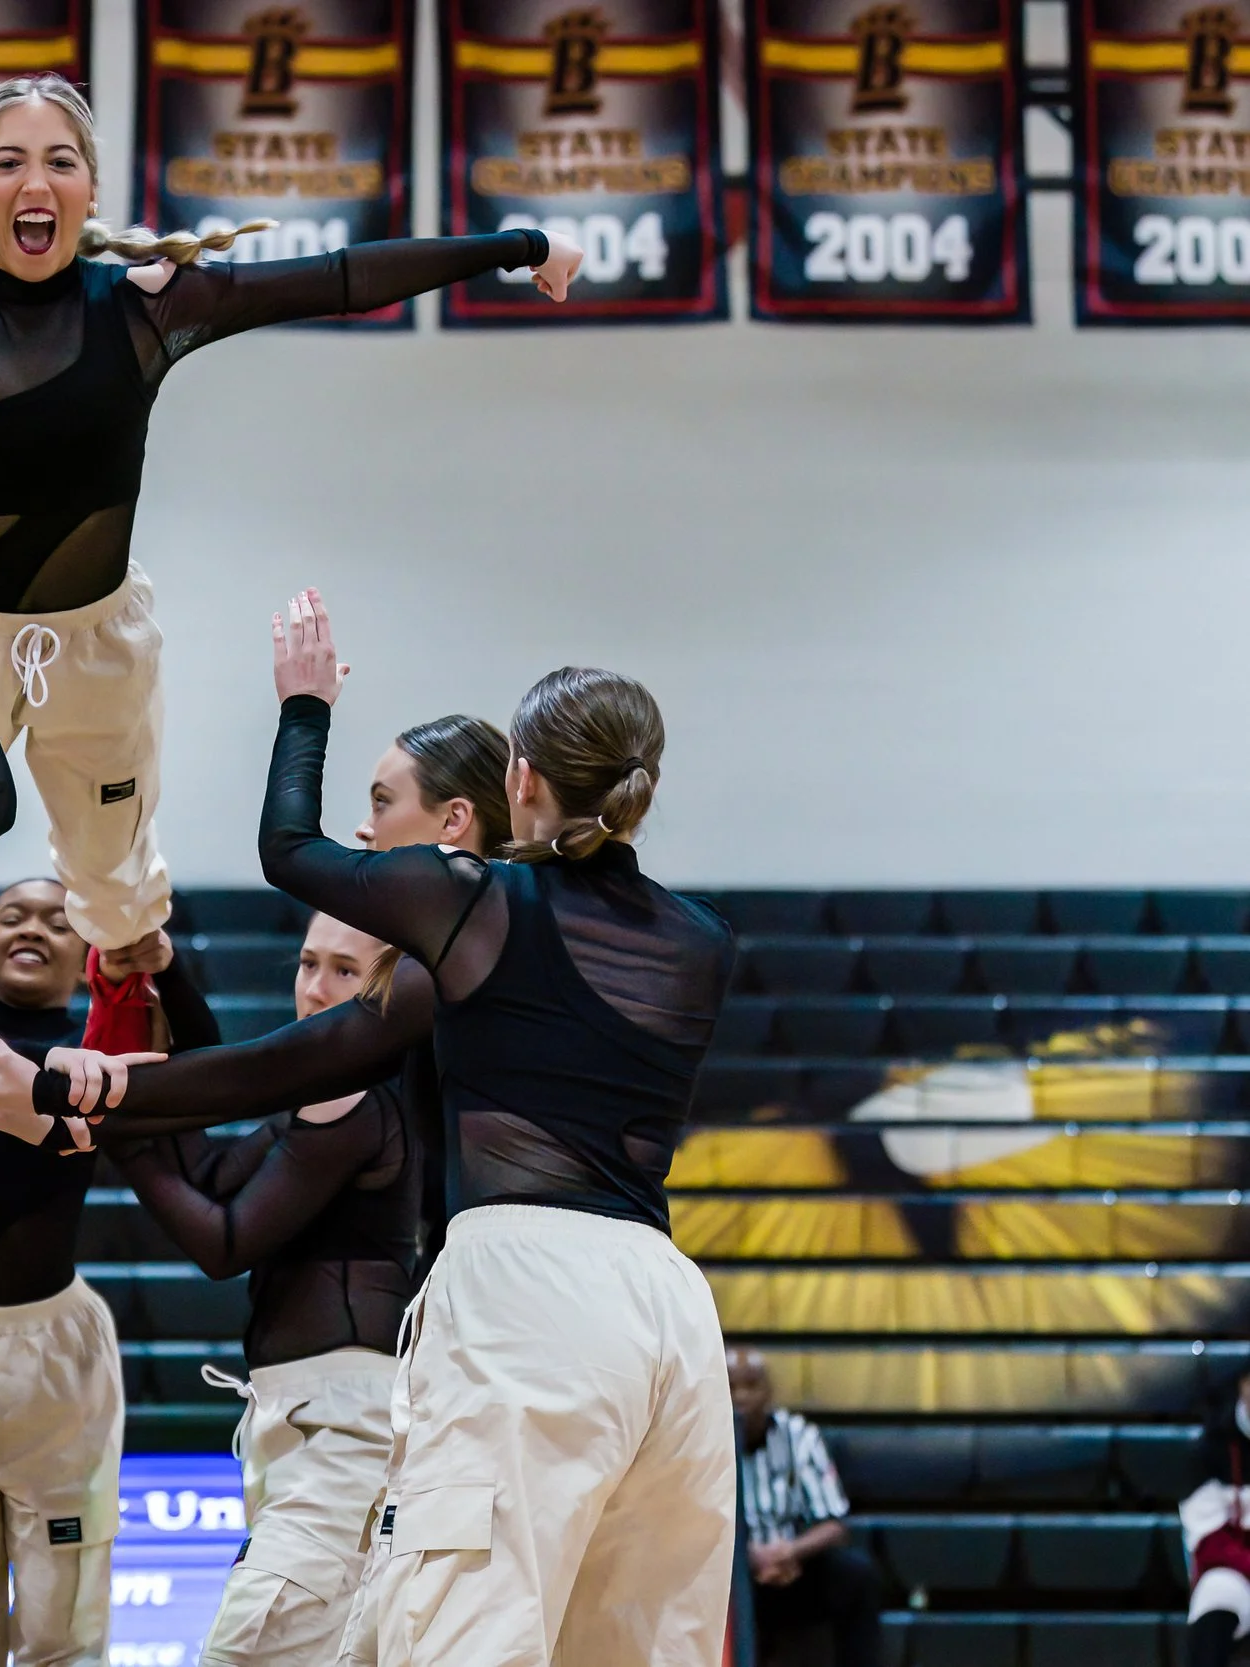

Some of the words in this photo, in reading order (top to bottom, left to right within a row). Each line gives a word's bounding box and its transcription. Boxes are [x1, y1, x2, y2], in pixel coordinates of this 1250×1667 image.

[212, 131, 338, 160] STATE
[516, 129, 642, 160] STATE
[827, 128, 946, 157] STATE
[803, 211, 973, 283] 2004
